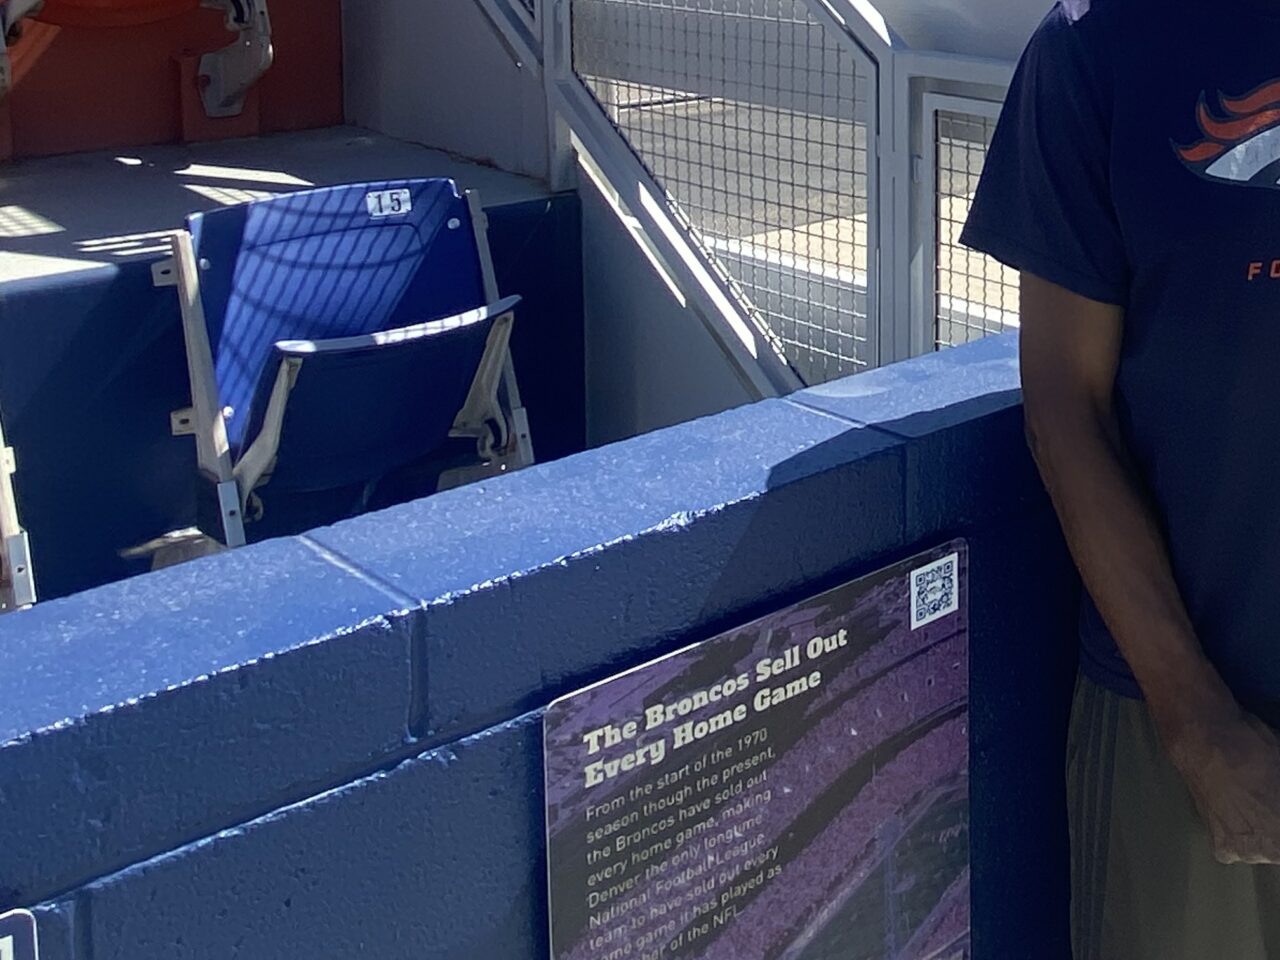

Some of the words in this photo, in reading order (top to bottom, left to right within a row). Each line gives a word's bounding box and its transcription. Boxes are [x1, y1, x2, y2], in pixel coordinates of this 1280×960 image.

[374, 192, 402, 213] 15
[583, 720, 637, 755] The
[645, 672, 750, 731] Broncos
[755, 645, 801, 682] Sell
[806, 628, 848, 659] Out
[584, 738, 666, 789] Every
[673, 703, 747, 750] Home
[754, 671, 822, 712] Game
[586, 795, 625, 822] From
[629, 784, 653, 802] the
[657, 764, 690, 790] start
[694, 754, 708, 772] of
[711, 747, 733, 765] the
[737, 727, 768, 751] 1970
[586, 811, 639, 844] season
[643, 784, 693, 816] though
[696, 772, 718, 791] the
[722, 747, 776, 781] present,
[586, 847, 611, 865] the
[615, 815, 675, 852] Broncos
[678, 799, 711, 822] have
[714, 781, 743, 804] sold
[747, 770, 768, 787] out
[587, 859, 628, 887] every
[631, 837, 672, 865] home
[722, 789, 771, 821] making
[588, 873, 641, 908] Denver
[645, 860, 668, 880] the
[671, 844, 701, 867] only
[704, 813, 763, 850] longtime
[588, 888, 650, 929] National
[655, 853, 714, 895] Football
[716, 833, 766, 866] League
[589, 924, 627, 950] team
[631, 915, 646, 929] to
[650, 895, 683, 920] have
[686, 876, 715, 901] sold
[719, 863, 740, 885] out
[744, 845, 779, 871] every
[636, 920, 676, 951] game
[692, 897, 718, 917] has
[720, 871, 764, 907] played
[767, 863, 783, 880] as
[669, 933, 684, 951] of
[687, 922, 710, 940] the
